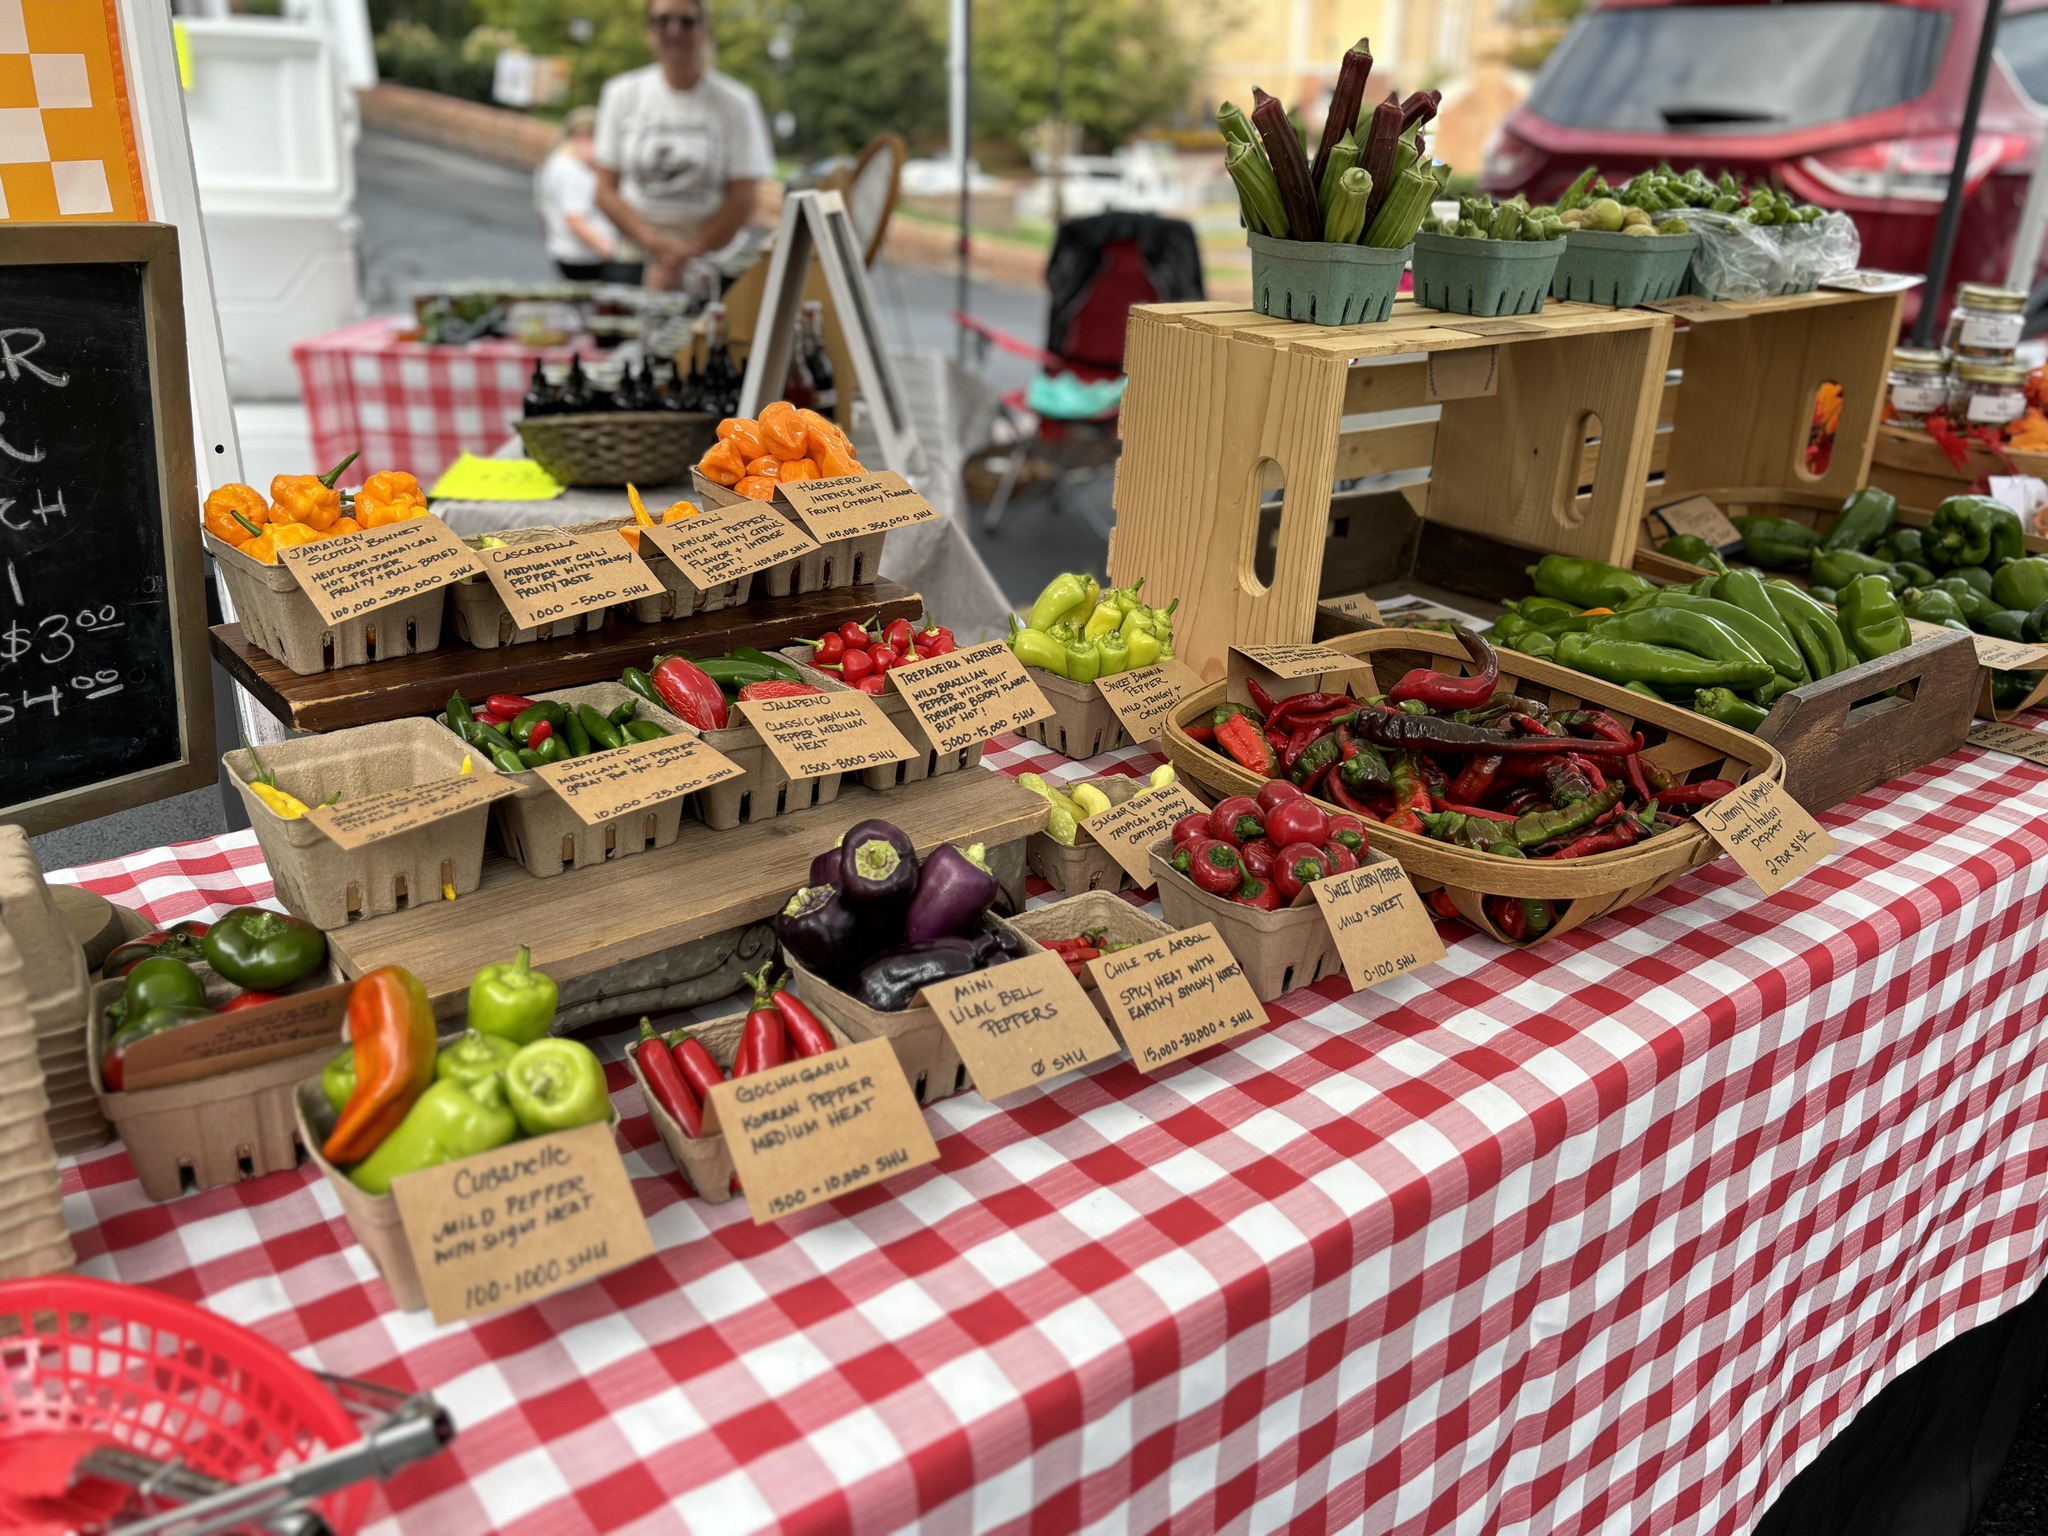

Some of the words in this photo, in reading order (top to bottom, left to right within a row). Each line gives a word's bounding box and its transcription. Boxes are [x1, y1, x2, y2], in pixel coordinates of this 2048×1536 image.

[797, 476, 862, 492] HABENERO
[810, 490, 854, 504] INTENSE
[856, 482, 883, 496] HEAT
[805, 503, 842, 517] FRUITY
[842, 495, 884, 511] CITRUSY
[882, 488, 918, 501] FLAVOR
[913, 509, 934, 522] SHU
[714, 532, 748, 550] FRUITY
[750, 518, 785, 537] CITRUS
[724, 513, 774, 536] PEPPER
[288, 533, 365, 560] JAMAICAN
[307, 544, 363, 567] SCOTCH
[367, 525, 423, 547] BONNET
[370, 535, 438, 563] JAMAICAN
[492, 539, 579, 563] CASCABELLA
[689, 553, 732, 570] FLAVOR
[748, 530, 785, 550] INTENSE
[790, 541, 810, 555] SHU
[321, 576, 345, 591] HOT
[351, 558, 404, 580] PEPPER
[329, 577, 375, 600] FRUITY
[386, 563, 418, 580] FULL
[418, 547, 459, 568] BODIED
[449, 564, 475, 579] SHU
[503, 561, 551, 579] MEDIUM
[553, 556, 573, 570] HOT
[509, 570, 561, 588] PEPPER
[594, 552, 633, 568] TANGY
[514, 580, 558, 600] FRUITY
[558, 572, 594, 588] TASTE
[528, 605, 564, 622] 1000
[622, 583, 650, 597] SHU
[898, 660, 962, 686] TREPADEIRA
[961, 643, 1008, 665] WERNER
[912, 688, 938, 701] WILD
[938, 668, 988, 694] BRAZILIAN
[918, 694, 957, 713] PEPPER
[958, 684, 981, 698] WITH
[983, 671, 1008, 689] FRUIT
[1103, 676, 1131, 692] SWEET
[1130, 667, 1164, 683] BANANA
[1123, 677, 1169, 697] PEPPER
[762, 695, 831, 712] JALAPENO
[923, 701, 967, 725] FORWARD
[968, 687, 1000, 706] BERRY
[1142, 688, 1173, 706] TANGY
[815, 708, 862, 724] MEXICAN
[934, 718, 957, 733] BUT
[1012, 707, 1036, 724] SHU
[773, 730, 816, 744] PEPPER
[818, 718, 868, 736] MEDIUM
[793, 738, 829, 752] HEAT
[557, 762, 619, 785] MEXICAN
[626, 753, 649, 766] HOT
[648, 741, 702, 759] PEPPER
[606, 770, 628, 781] FOR
[656, 750, 697, 768] SAUCE
[868, 749, 898, 762] SHU
[706, 768, 734, 782] SHU
[332, 792, 395, 813] LEMON
[418, 790, 464, 808] HEAT
[1091, 807, 1138, 832] SUGAR
[1127, 797, 1152, 811] RUSH
[1151, 787, 1181, 803] PEACH
[333, 809, 384, 828] FROM
[1109, 816, 1150, 841] TROPICAL
[1159, 798, 1188, 817] SMOKY
[1129, 819, 1172, 845] COMPLEX
[1169, 806, 1201, 822] FLAVOR
[1705, 800, 1751, 831] Jimmy
[1766, 860, 1780, 875] 2
[1774, 850, 1794, 867] FOR
[1324, 883, 1352, 903] SWEET
[1350, 871, 1383, 894] CHERRY
[1378, 865, 1405, 885] PEPPER
[1337, 912, 1363, 930] MILD
[1370, 893, 1404, 916] SWEET
[1104, 957, 1140, 980] CHILE
[1144, 948, 1165, 962] DE
[1169, 933, 1211, 955] ARBOL
[1397, 954, 1417, 970] SHU
[1119, 982, 1154, 1006] SPICY
[1154, 969, 1184, 989] HEAT
[1187, 953, 1215, 975] WITH
[998, 986, 1044, 1007] BELL
[1128, 992, 1175, 1021] EARTHY
[1178, 973, 1215, 999] SMOKY
[979, 1002, 1058, 1037] PEPPERS
[1230, 1008, 1254, 1028] SHU
[1052, 1048, 1088, 1071] SHU
[741, 1101, 799, 1133] KOREAN
[806, 1076, 875, 1112] PEPPER
[826, 1096, 876, 1128] HEAT
[769, 1191, 807, 1214] 1500
[875, 1148, 909, 1173] SHU
[505, 1175, 587, 1216] PEPPER
[545, 1193, 595, 1225] HEAT
